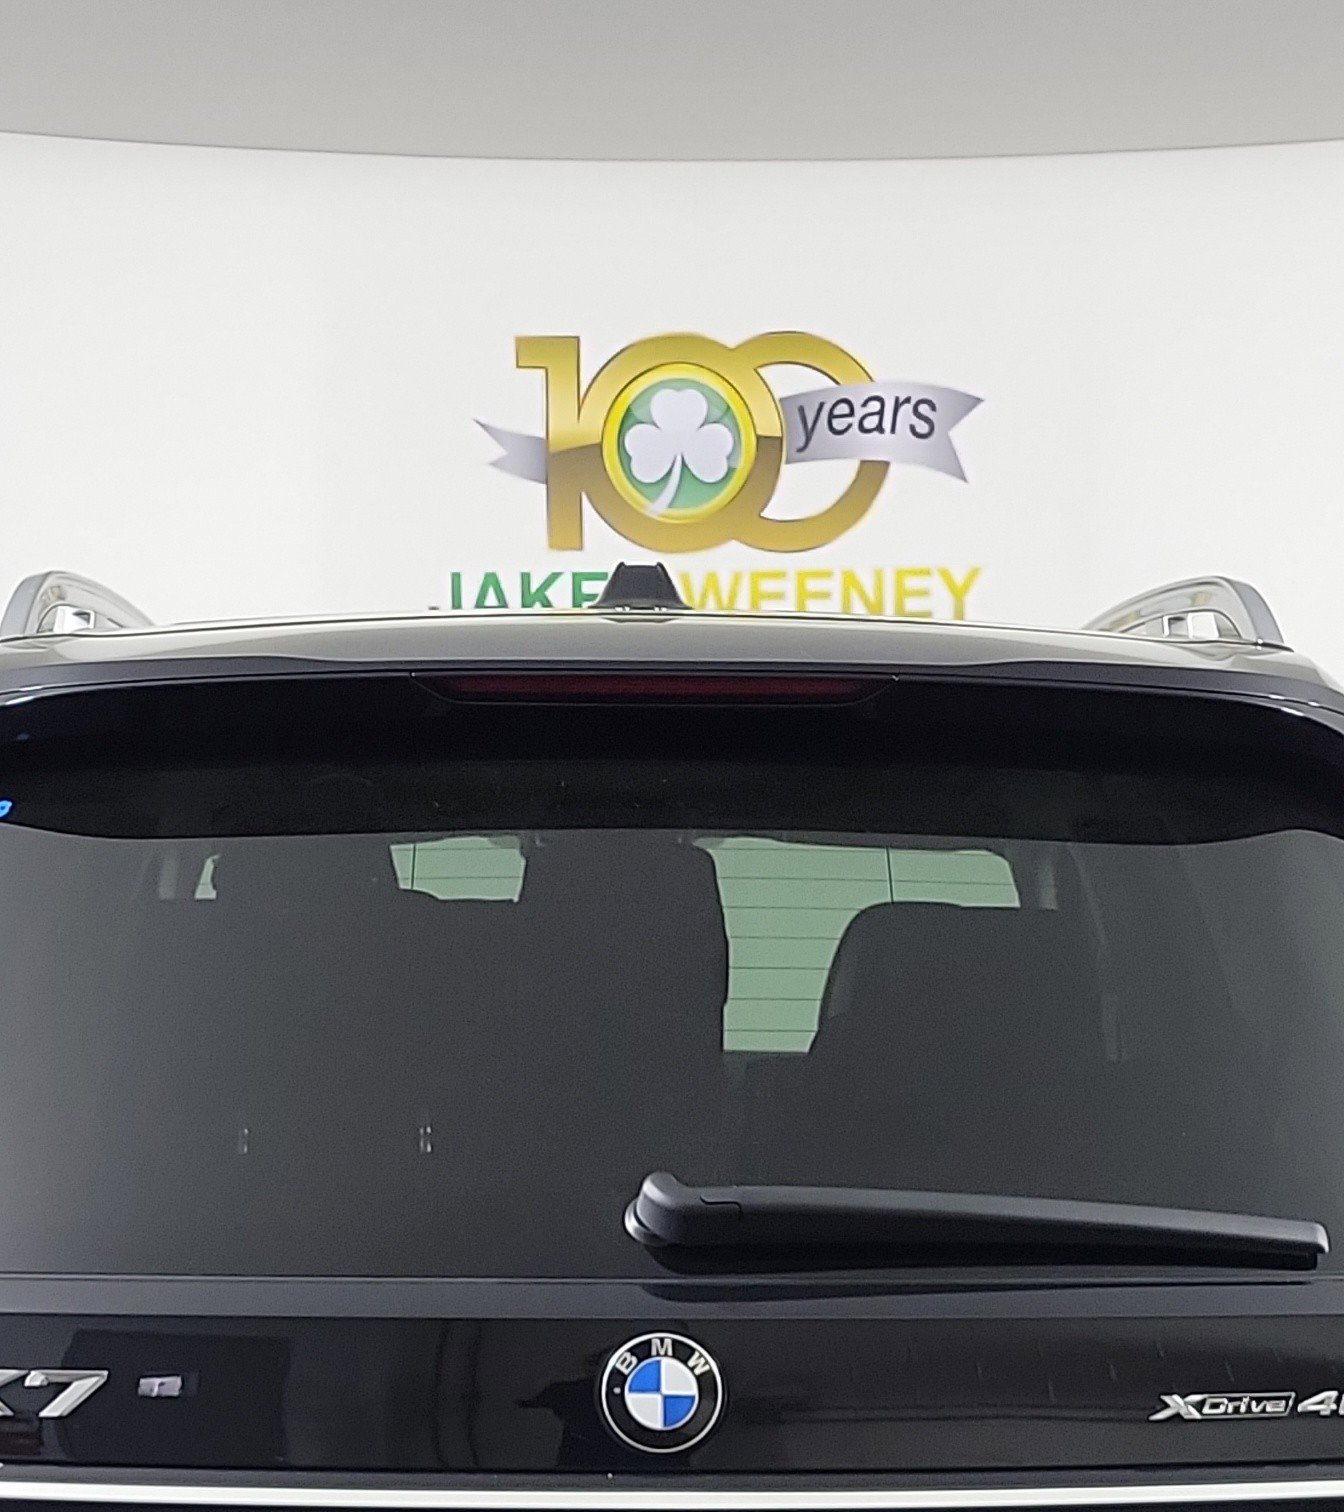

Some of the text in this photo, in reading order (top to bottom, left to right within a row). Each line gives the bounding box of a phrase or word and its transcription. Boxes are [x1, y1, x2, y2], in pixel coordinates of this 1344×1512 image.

[796, 394, 938, 453] years
[679, 567, 982, 621] WEENEY
[615, 1338, 710, 1375] BMW
